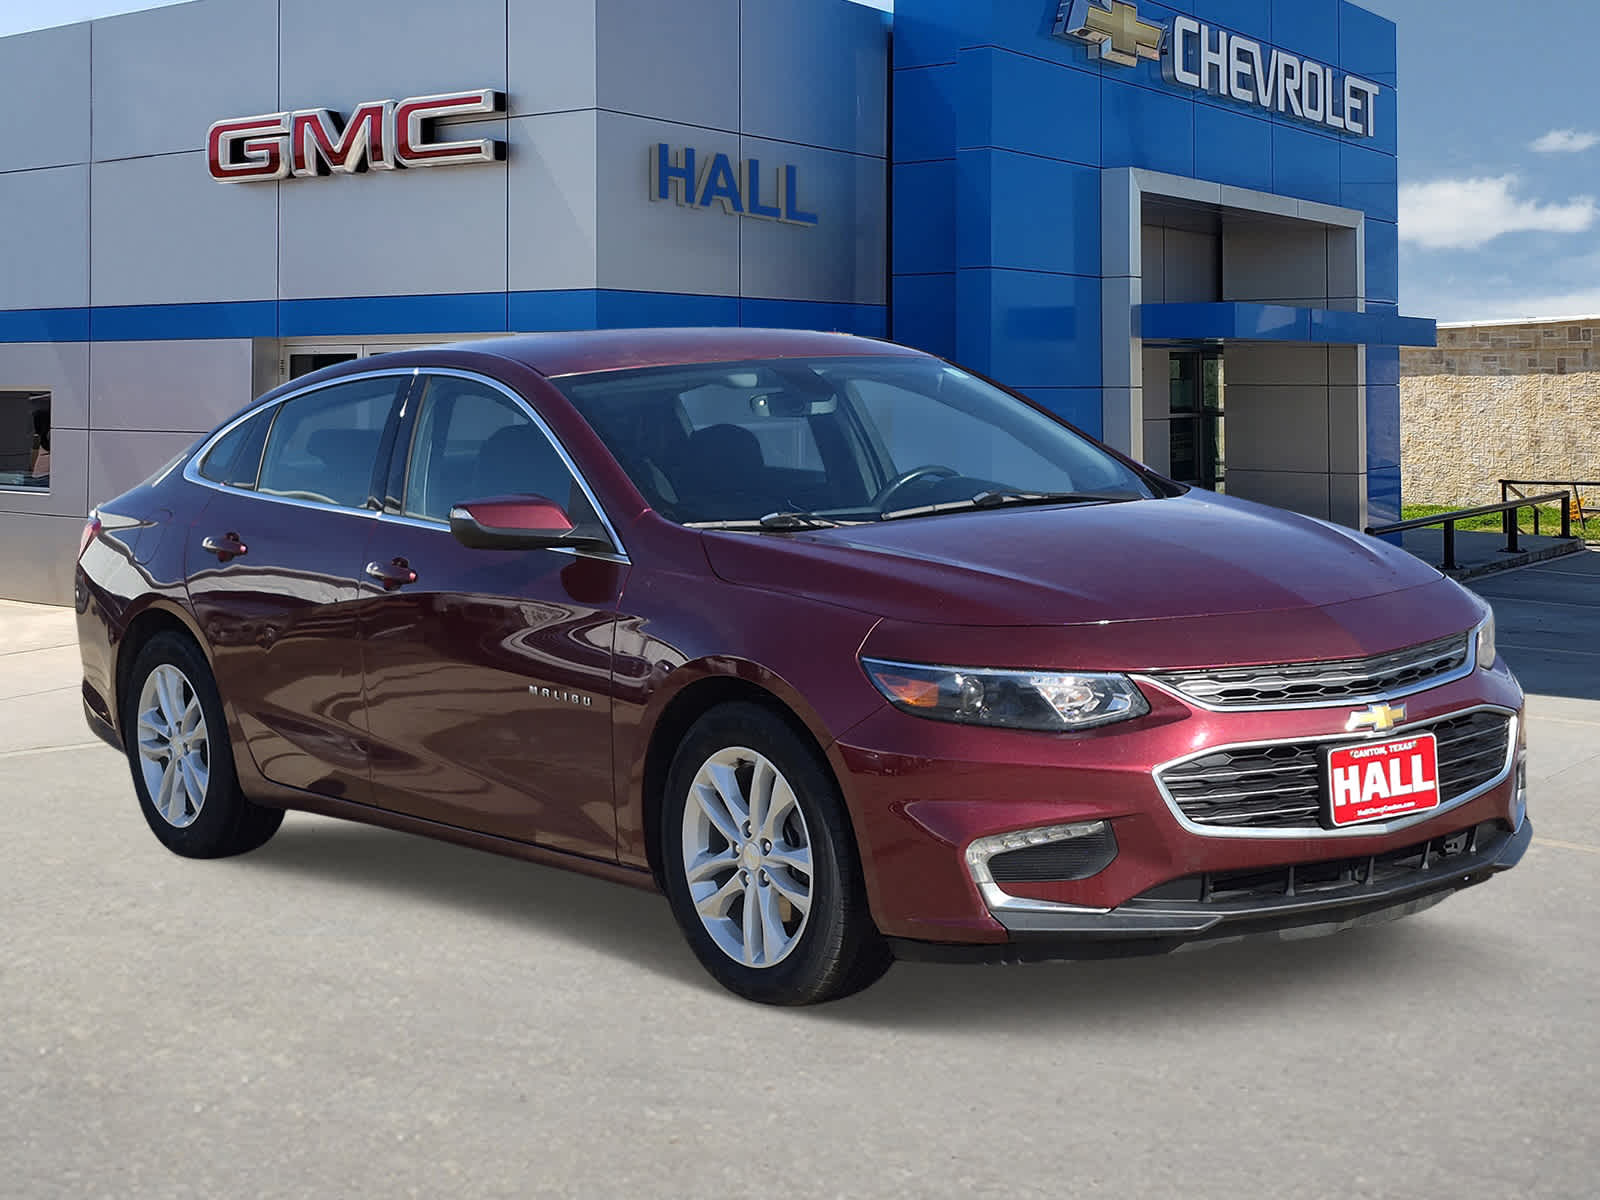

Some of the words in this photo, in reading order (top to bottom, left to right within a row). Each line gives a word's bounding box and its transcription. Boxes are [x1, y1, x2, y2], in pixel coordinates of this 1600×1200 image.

[1173, 15, 1380, 137] CHEVROLET
[208, 88, 506, 183] GMC
[652, 143, 819, 226] HALL
[528, 685, 592, 706] MALIBU
[1333, 754, 1435, 806] HALL
